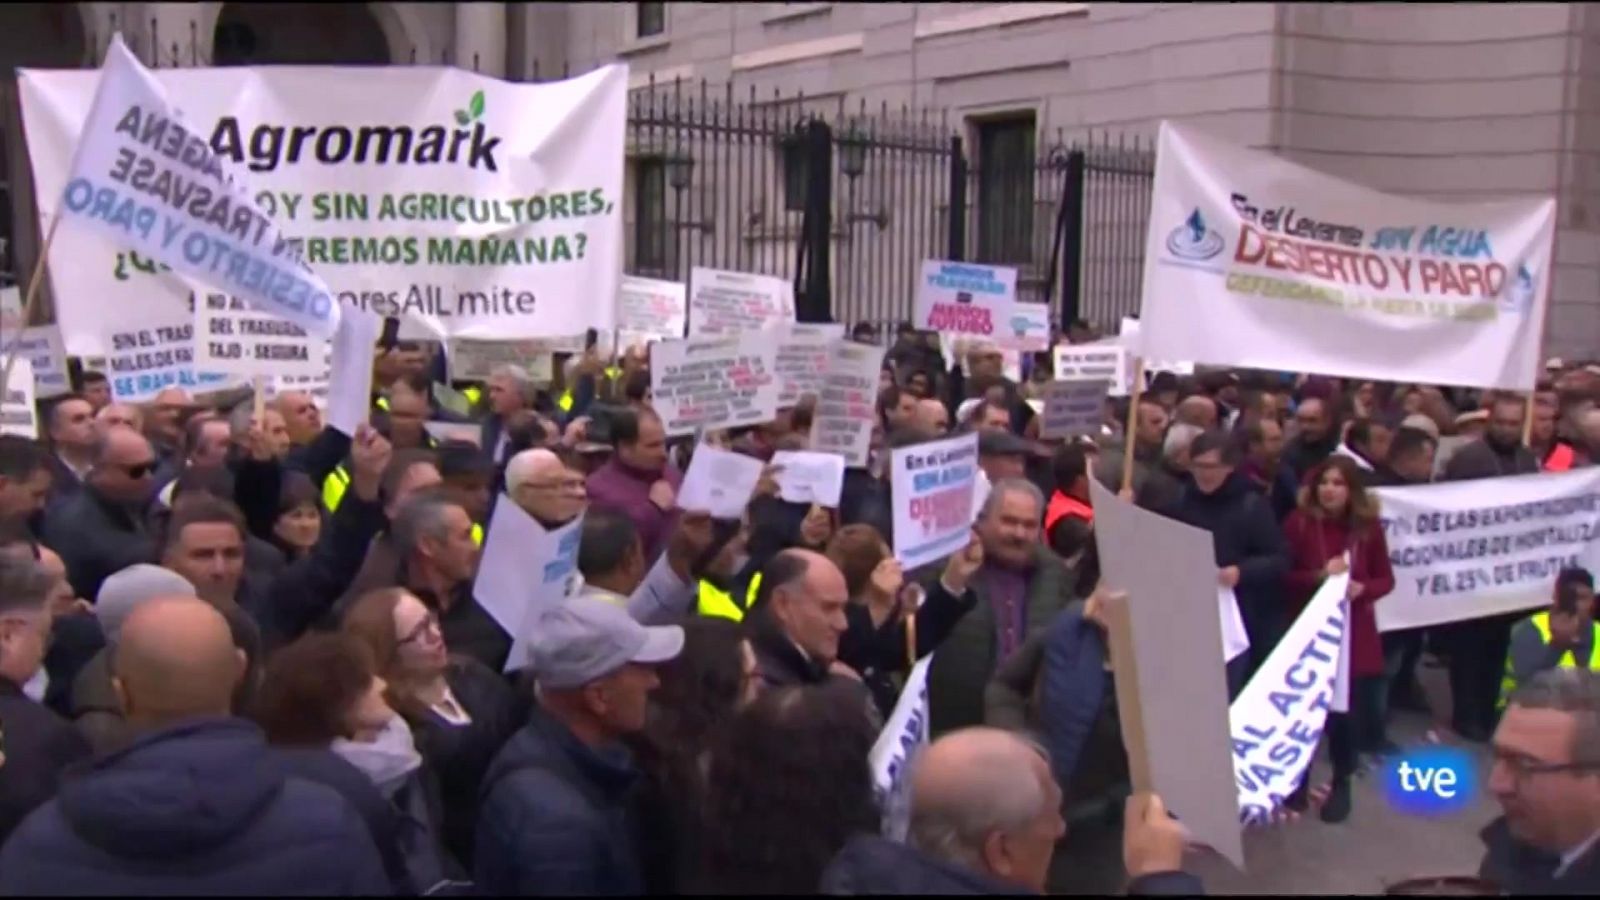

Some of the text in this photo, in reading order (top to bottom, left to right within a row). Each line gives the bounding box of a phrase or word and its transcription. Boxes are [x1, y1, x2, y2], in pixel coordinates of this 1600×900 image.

[209, 116, 502, 172] Agromark
[312, 193, 369, 221] SIN
[377, 187, 613, 224] AGRICULTORES,
[427, 231, 588, 266] MAÑANA?
[1417, 224, 1494, 260] AGUA
[1234, 222, 1389, 291] DESIERTO
[1390, 256, 1413, 294] Y
[1418, 258, 1508, 299] PARO
[206, 293, 226, 310] NO
[112, 323, 194, 351] SIN EL TRAS
[208, 317, 234, 335] DEL
[208, 340, 242, 360] TAJO
[253, 343, 309, 362] SEGURA
[114, 376, 135, 397] SE
[1416, 511, 1442, 535] DE
[1443, 507, 1478, 532] LAS
[1489, 533, 1511, 556] DE
[1415, 575, 1429, 597] Y
[1430, 573, 1451, 595] EL
[1493, 564, 1514, 585] DE
[1231, 724, 1278, 760] AL
